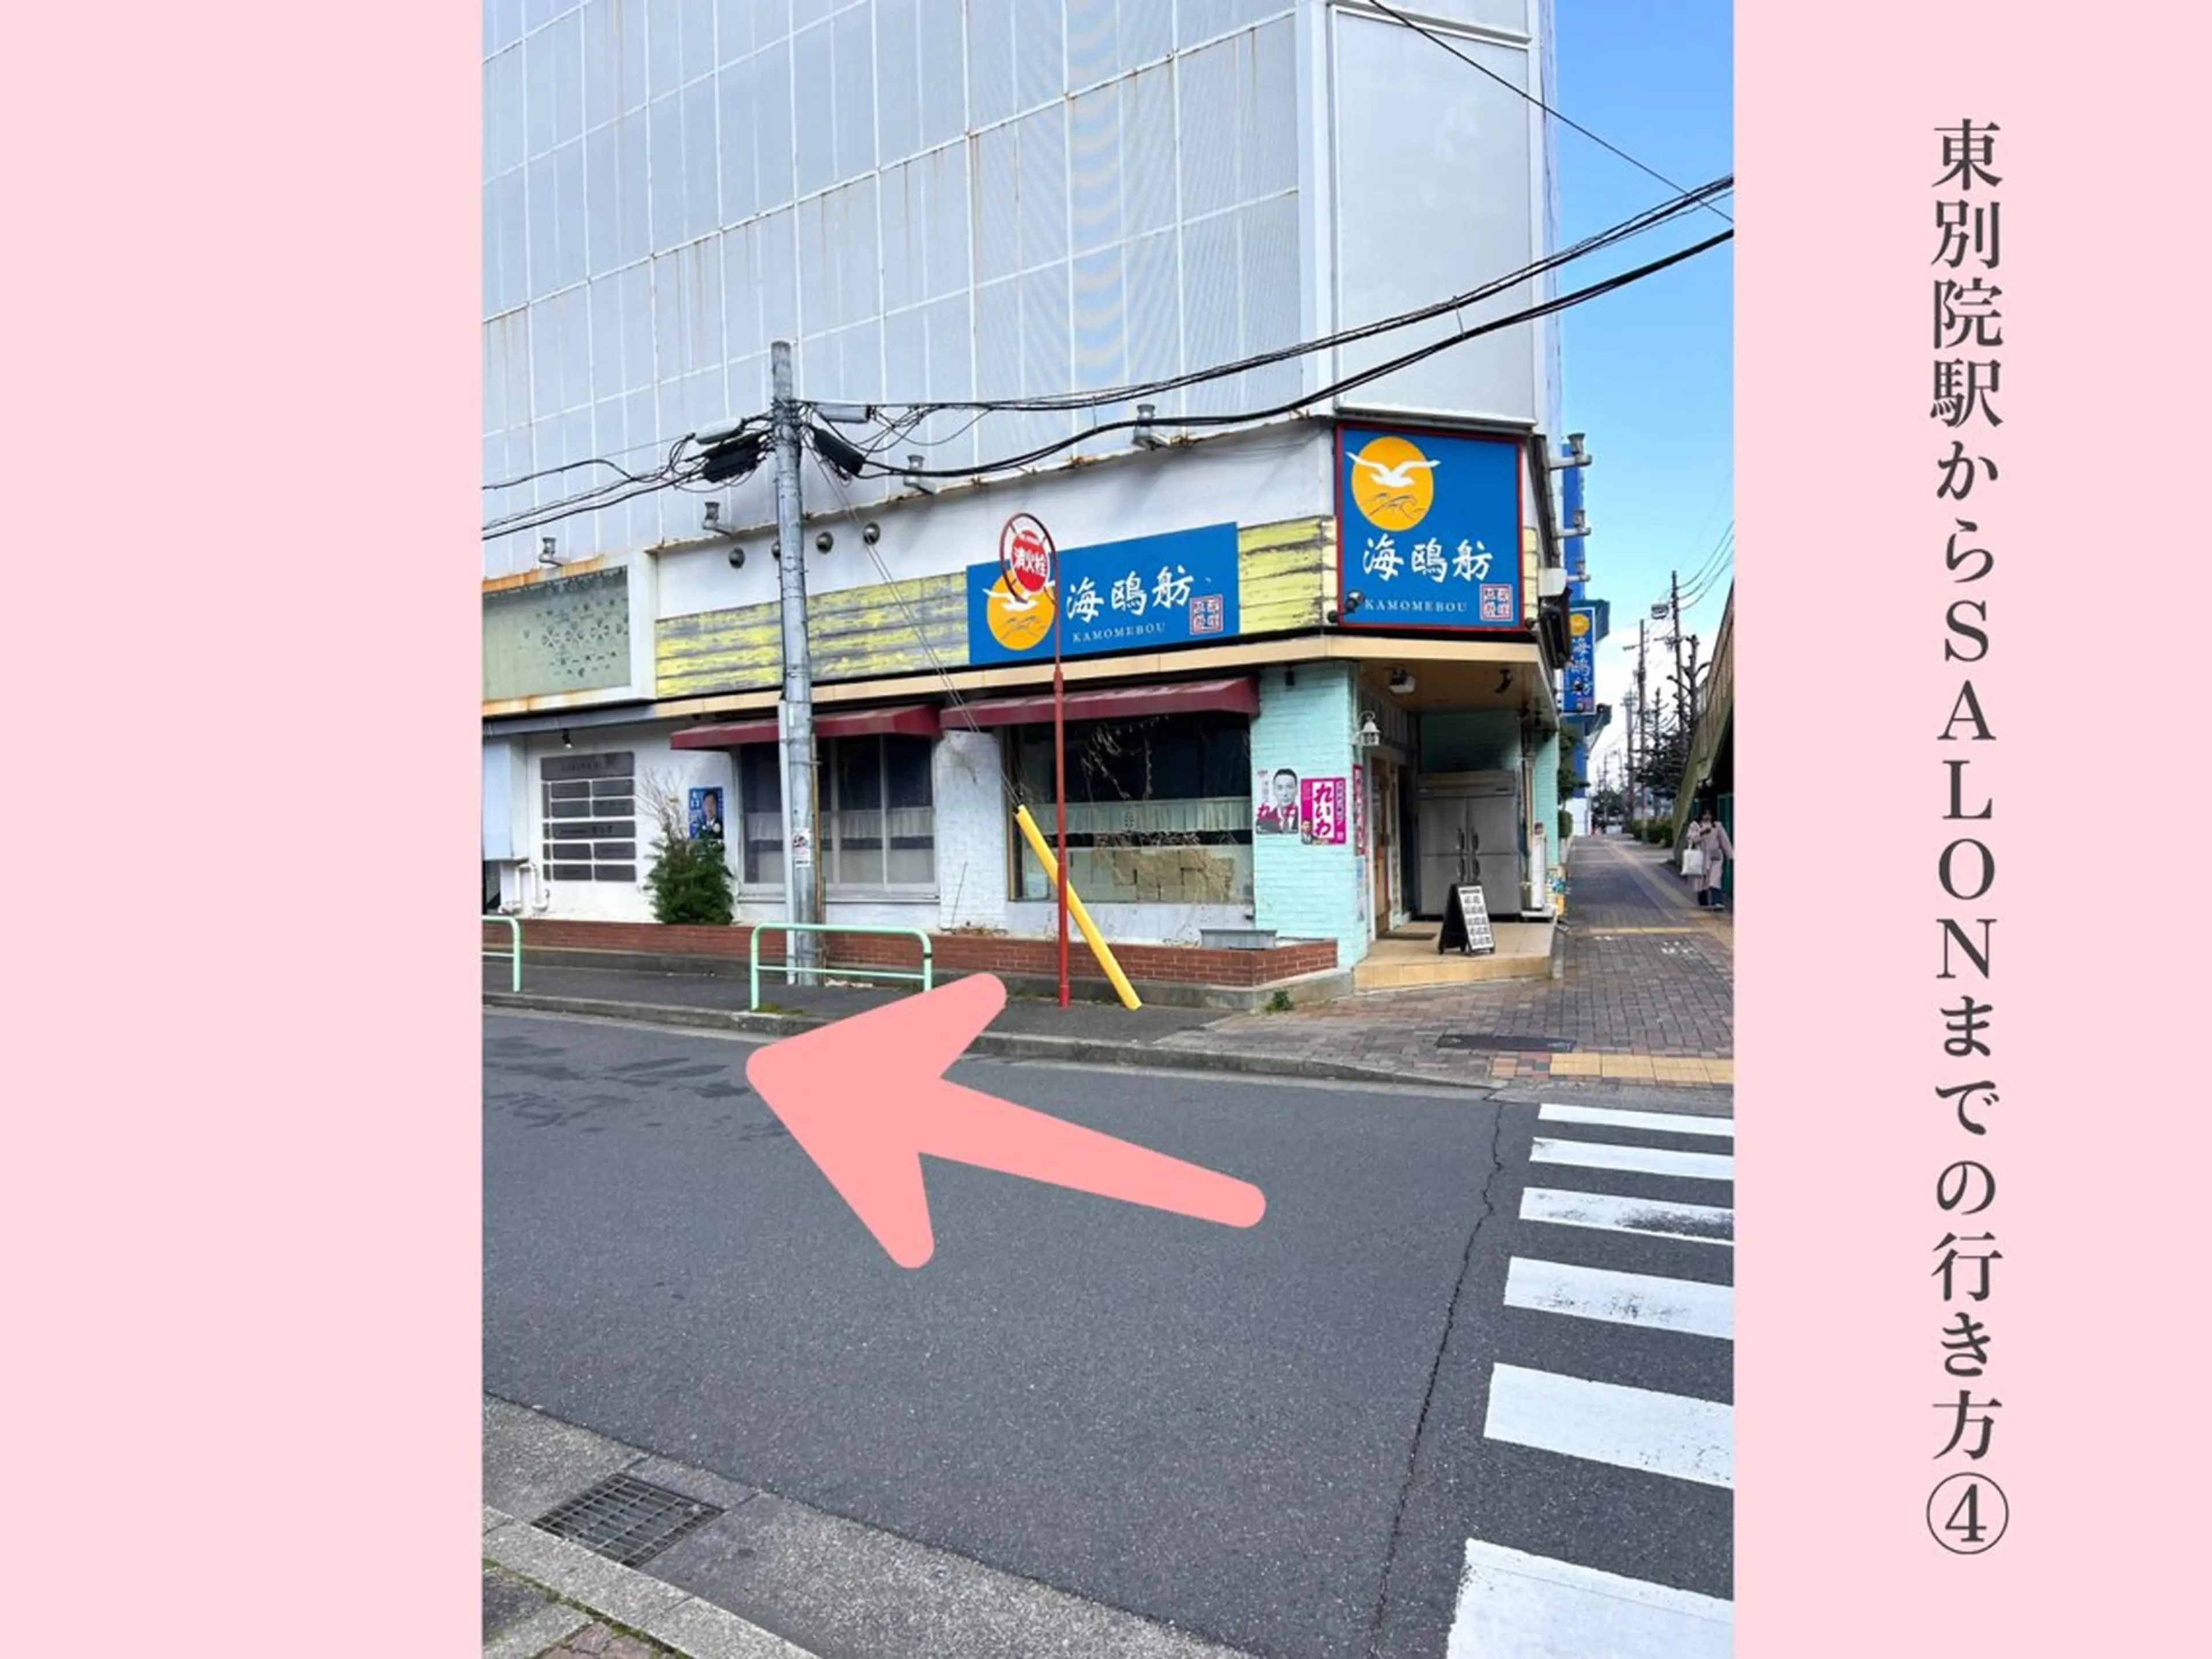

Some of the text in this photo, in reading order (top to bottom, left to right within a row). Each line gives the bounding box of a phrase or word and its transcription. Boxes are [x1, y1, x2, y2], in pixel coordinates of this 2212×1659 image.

[1013, 546, 1047, 578] 消火栓
[1365, 599, 1467, 612] KAMOMEBOU
[1073, 622, 1166, 643] KAMOMEBOU
[1314, 783, 1332, 835] れいわ
